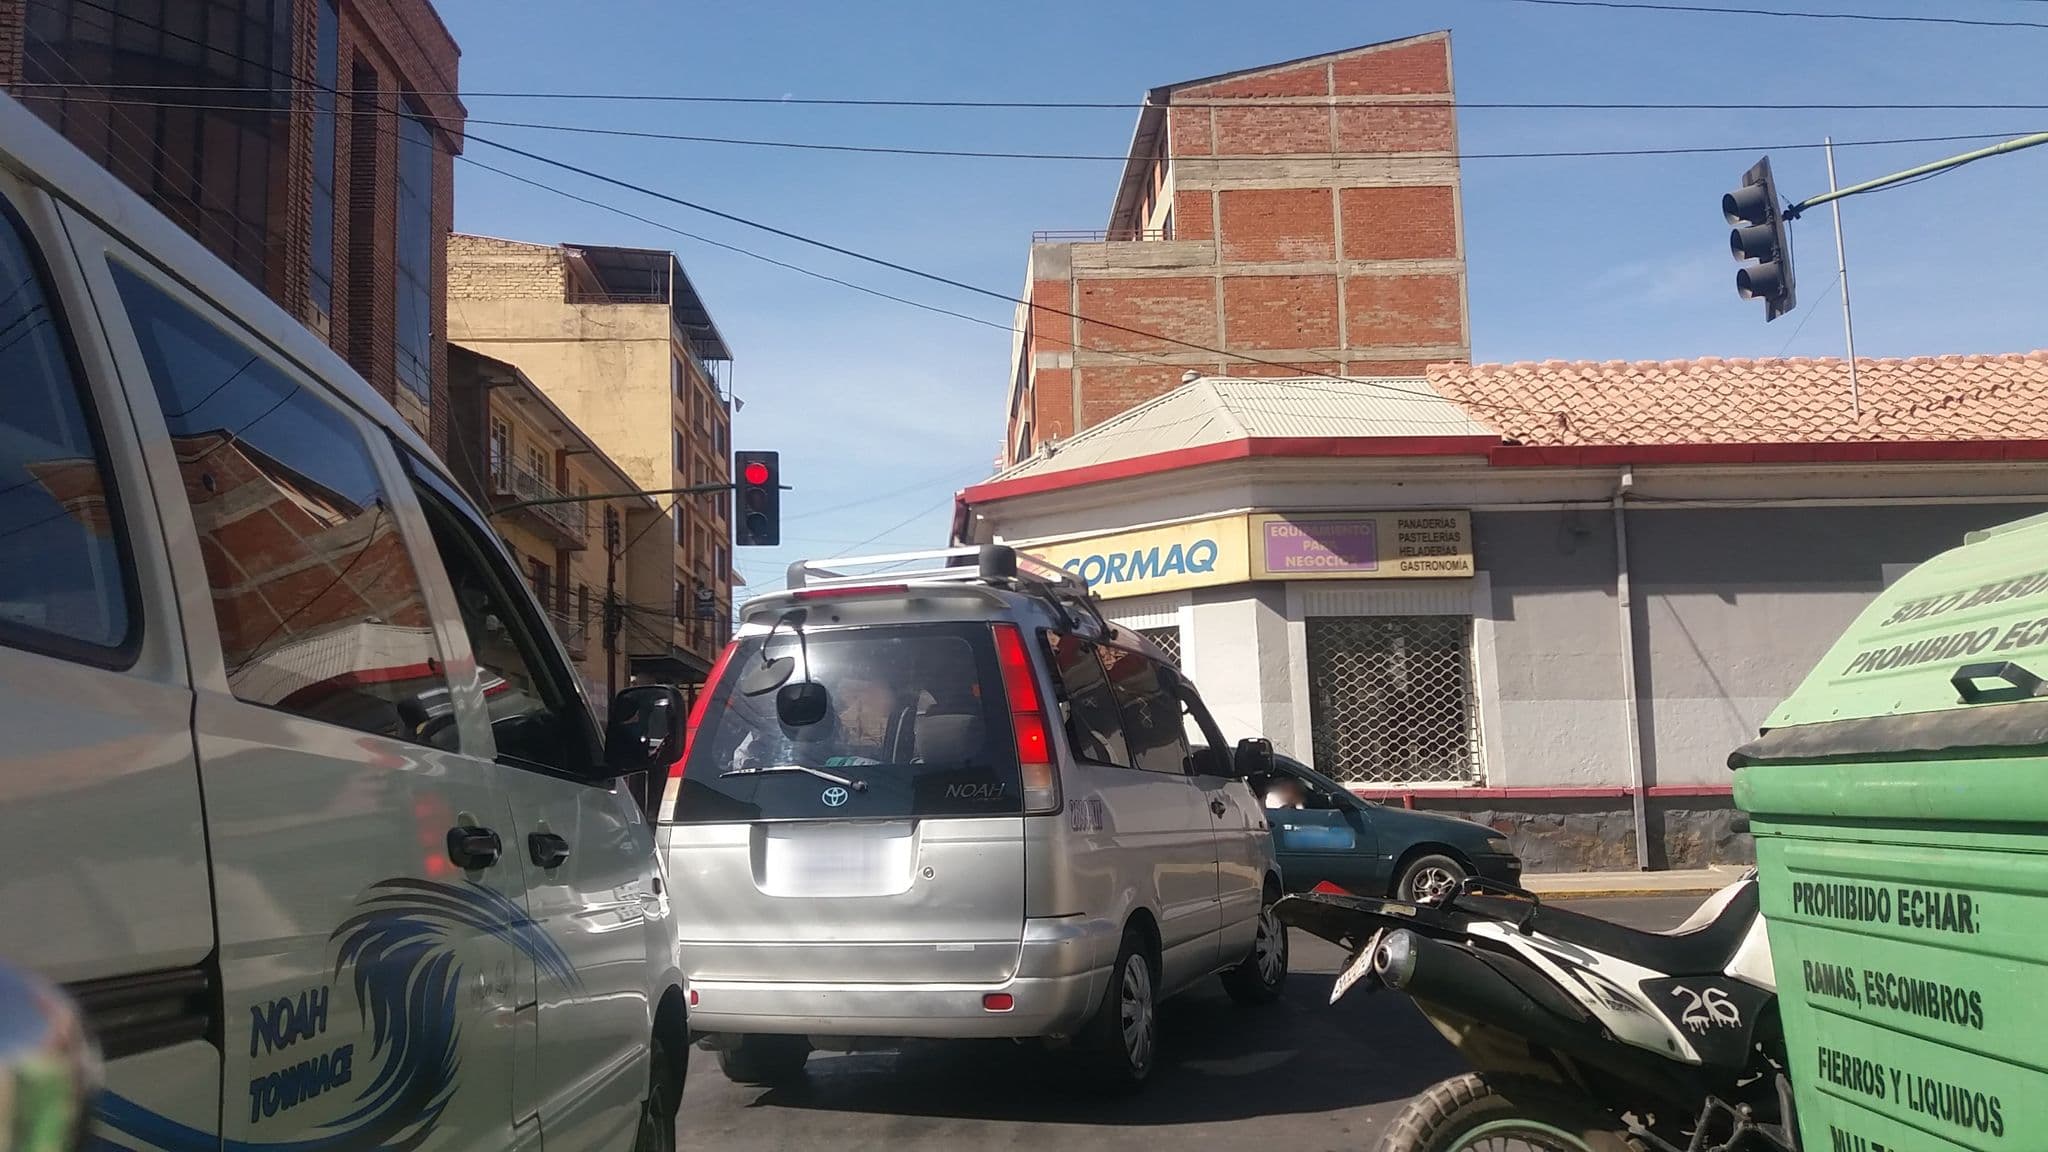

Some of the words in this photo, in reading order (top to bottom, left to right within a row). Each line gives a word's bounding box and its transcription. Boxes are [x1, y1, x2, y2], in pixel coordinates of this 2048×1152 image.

[1062, 539, 1218, 588] CORMAQ
[1400, 558, 1469, 572] GASTRONOMÍA
[1880, 592, 1967, 627] SOLO
[1953, 572, 2048, 611] BASU
[1842, 627, 1999, 676] PROHIBIDO
[945, 783, 1006, 799] NOAH
[1793, 882, 1891, 924] PROHIBIDO
[1897, 889, 1980, 934] ECHAR:
[1671, 985, 1742, 1036] 26
[1803, 960, 1862, 1010] RAMAS,
[1864, 969, 1984, 1031] ESCOMBROS
[250, 985, 329, 1059] NOAH
[249, 1043, 354, 1124] TOWNACE
[1818, 1046, 1885, 1100] FIERROS
[1890, 1068, 1902, 1105] Y
[1906, 1072, 2004, 1138] LIQUIDOS
